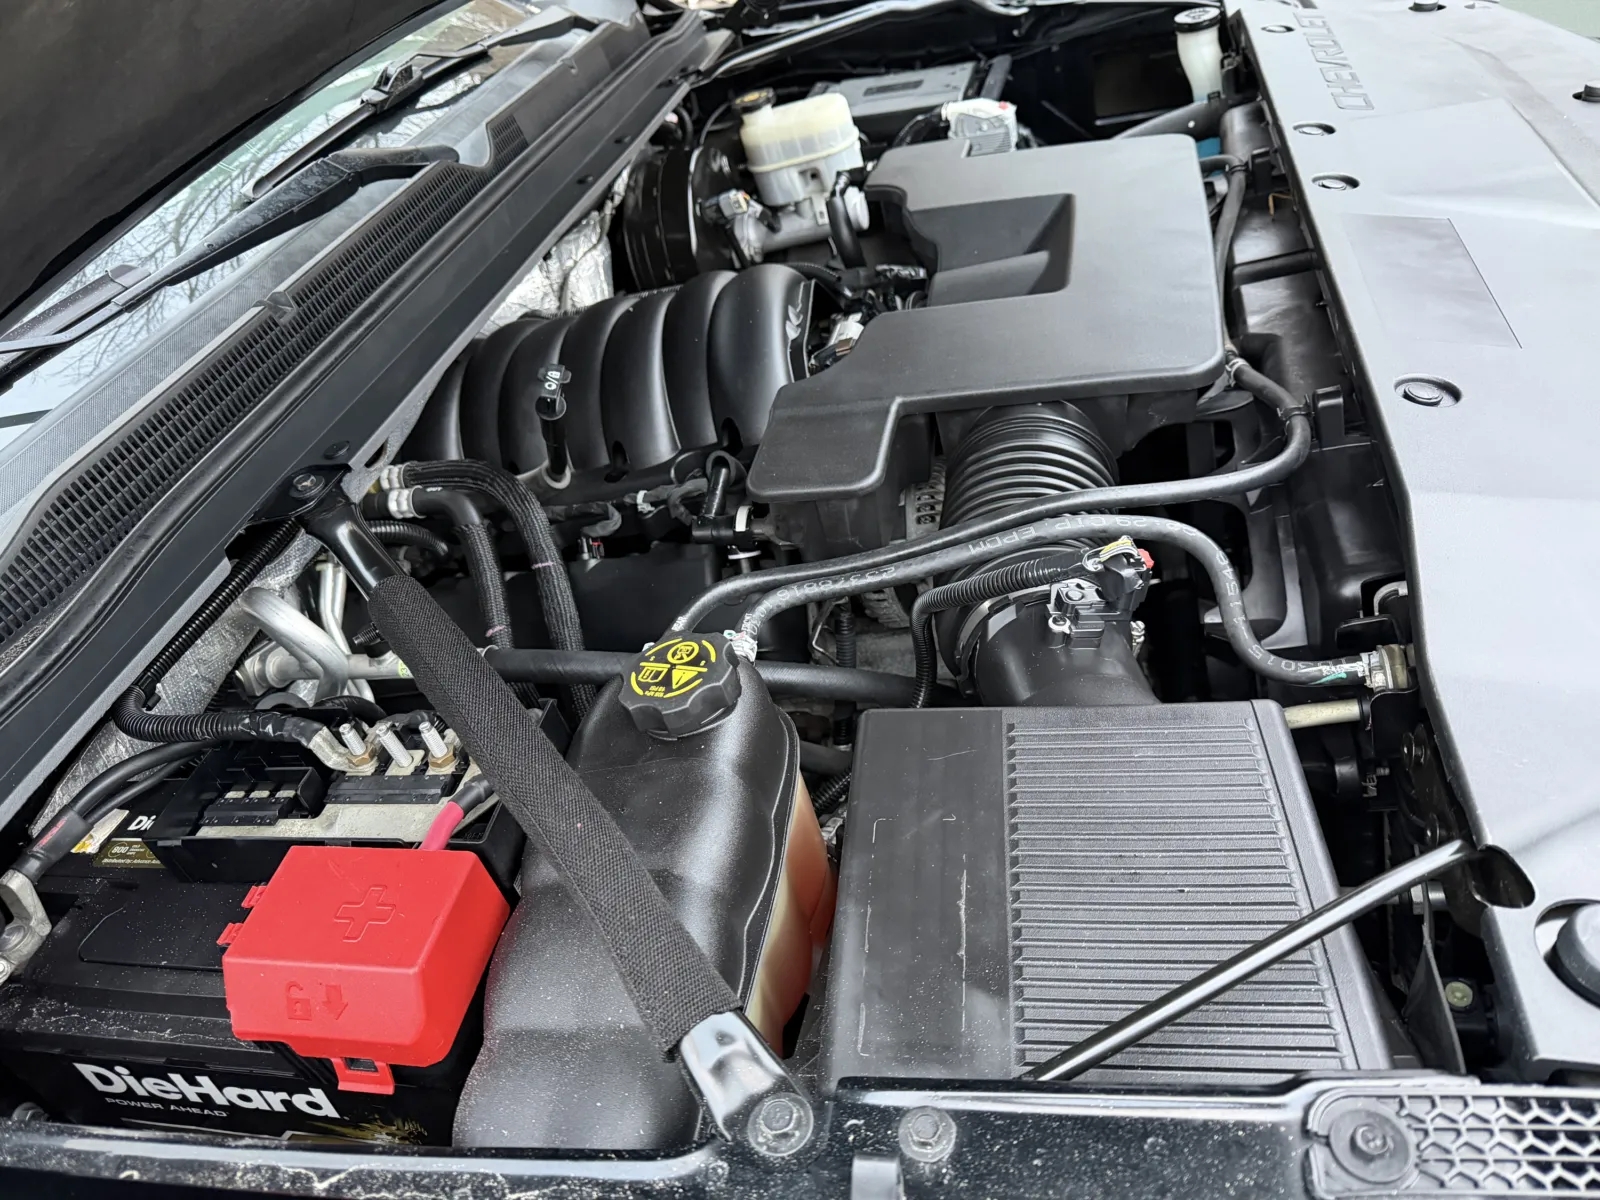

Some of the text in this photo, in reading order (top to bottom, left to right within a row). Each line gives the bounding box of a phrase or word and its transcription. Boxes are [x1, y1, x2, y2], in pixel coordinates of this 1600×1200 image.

[1292, 11, 1375, 110] CHEVROLET
[968, 525, 1036, 555] EPDM
[72, 1062, 341, 1120] DieHard
[105, 1097, 229, 1118] POWER AHEAD
